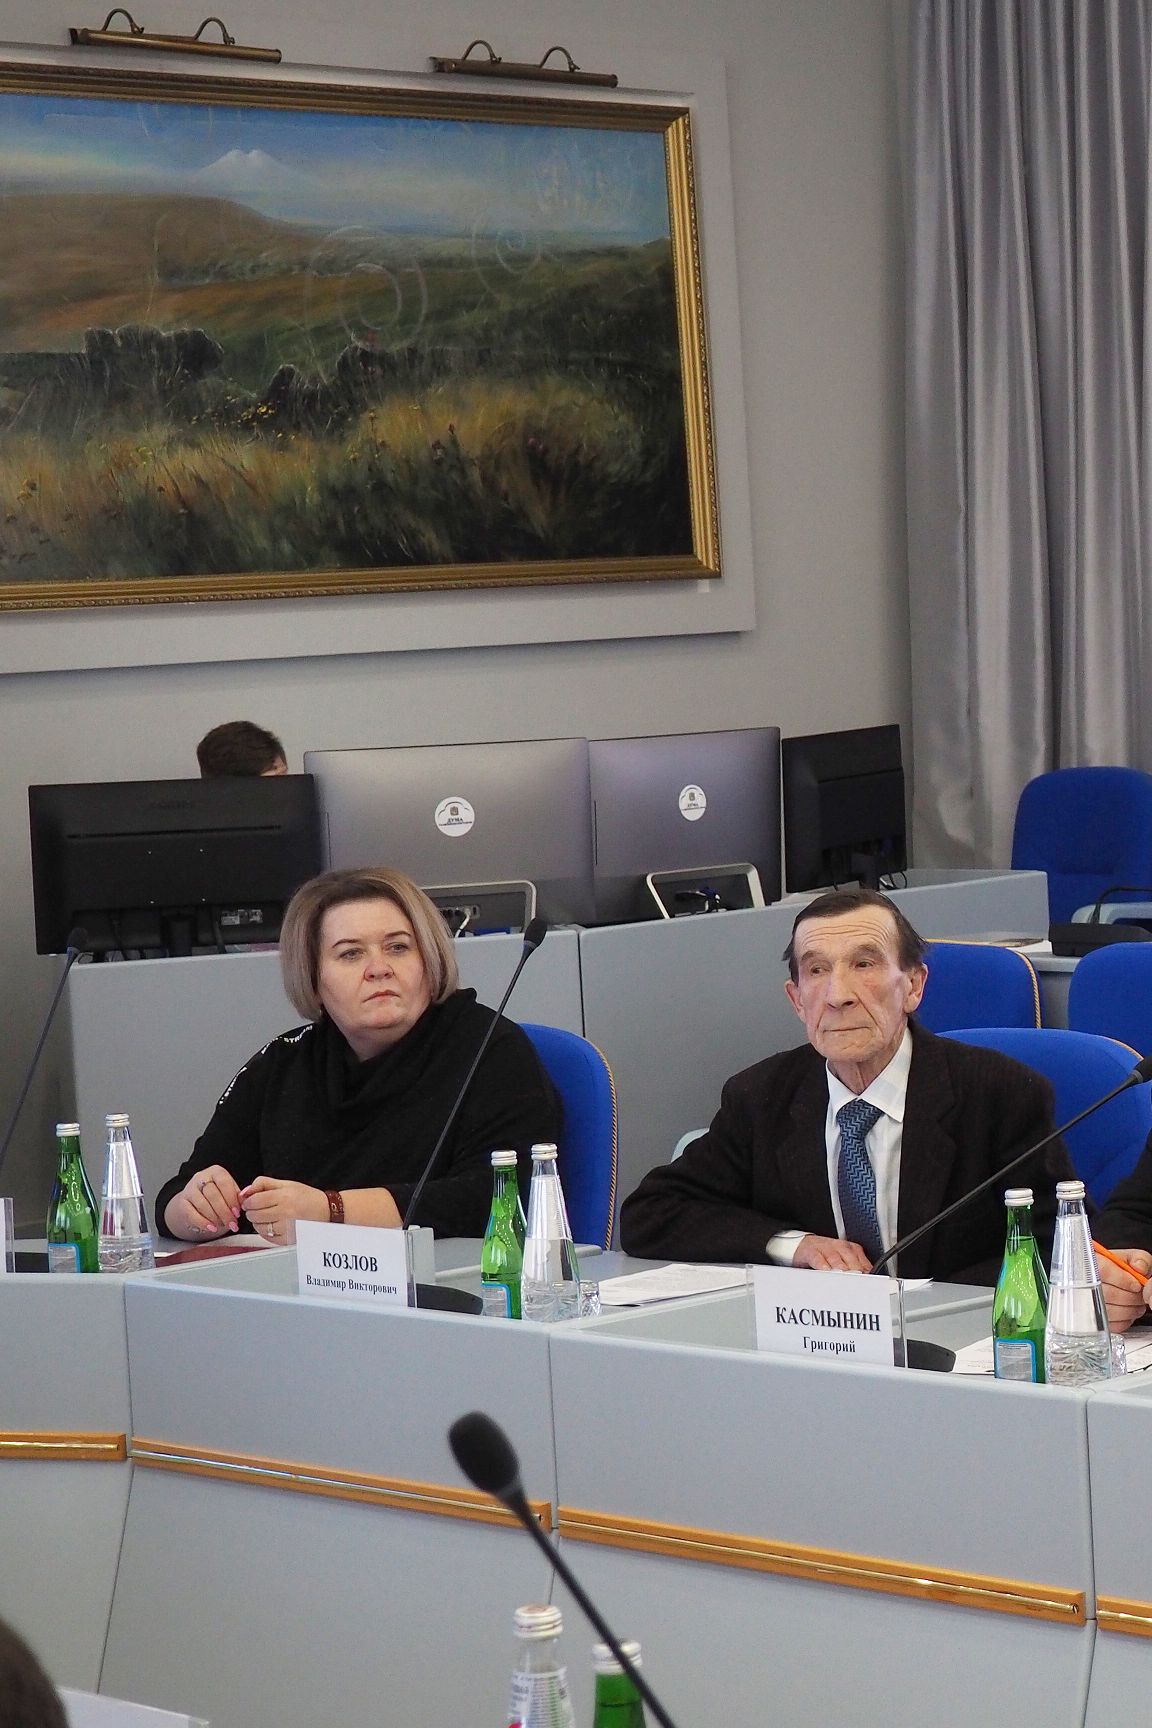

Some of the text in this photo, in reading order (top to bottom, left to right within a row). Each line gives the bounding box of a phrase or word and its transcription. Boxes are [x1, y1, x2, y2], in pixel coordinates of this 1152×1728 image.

[322, 1251, 378, 1273] КОЗЛОВ
[306, 1274, 398, 1295] Владимир Викторович
[775, 1306, 881, 1332] КАСМЫНИН
[803, 1336, 856, 1355] Григорий
